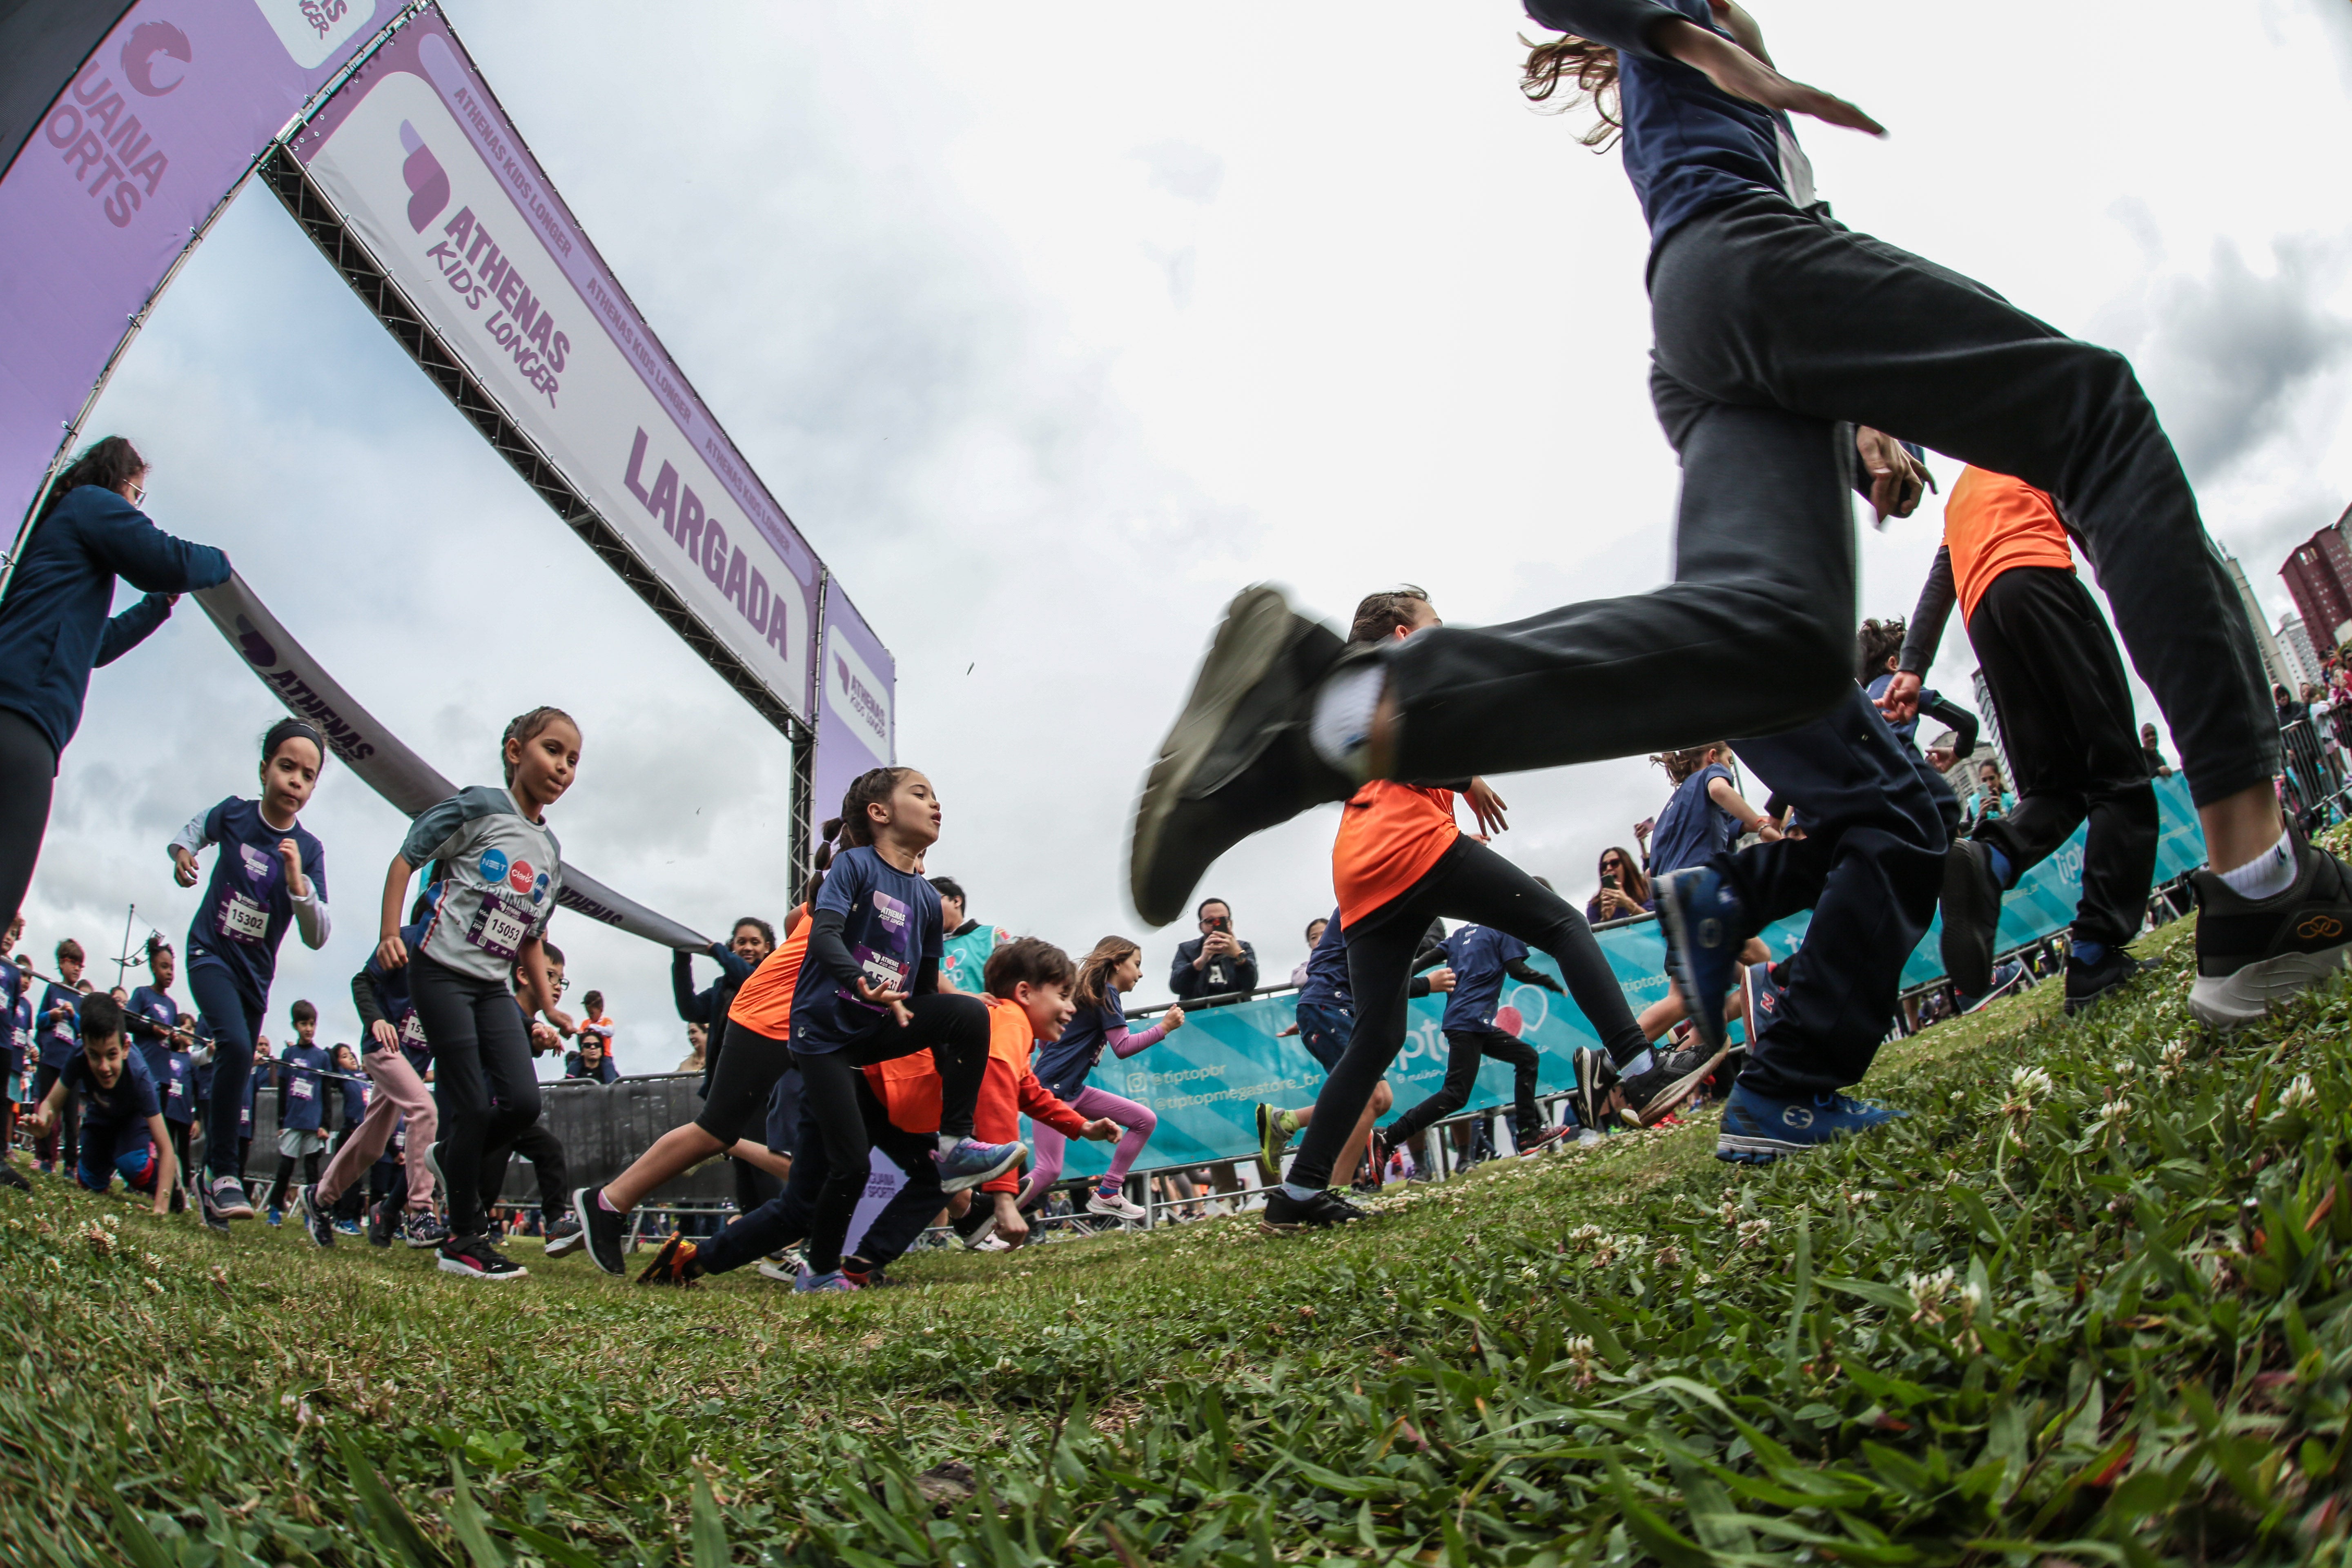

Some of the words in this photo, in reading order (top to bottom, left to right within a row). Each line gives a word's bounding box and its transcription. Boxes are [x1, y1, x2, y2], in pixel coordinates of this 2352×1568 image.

[454, 88, 506, 162] ATHENAS
[502, 156, 531, 199] KIDS
[528, 193, 572, 258] LONGER
[444, 205, 570, 373] ATHENAS
[426, 241, 488, 310] KIDS
[485, 310, 559, 408] LONGER
[587, 277, 633, 344] ATHENAS
[632, 334, 656, 376] KIDS
[655, 369, 691, 423] LONGER
[706, 437, 744, 495] ATHENAS
[743, 488, 762, 518] KIDS
[762, 510, 791, 555] LONGER
[624, 425, 787, 662] LARGADA
[270, 670, 374, 760] ATHENAS
[851, 675, 885, 726] ATHENAS
[481, 858, 507, 871] NET
[511, 869, 533, 883] Claro
[232, 909, 264, 929] 15302
[491, 919, 520, 941] 15053
[881, 906, 906, 922] ATHENAS
[890, 918, 904, 927] LONGER
[880, 956, 900, 968] ATHENAS
[1152, 1064, 1227, 1085] @tiptopbr
[1154, 1073, 1321, 1111] @tiptopmegastore_br
